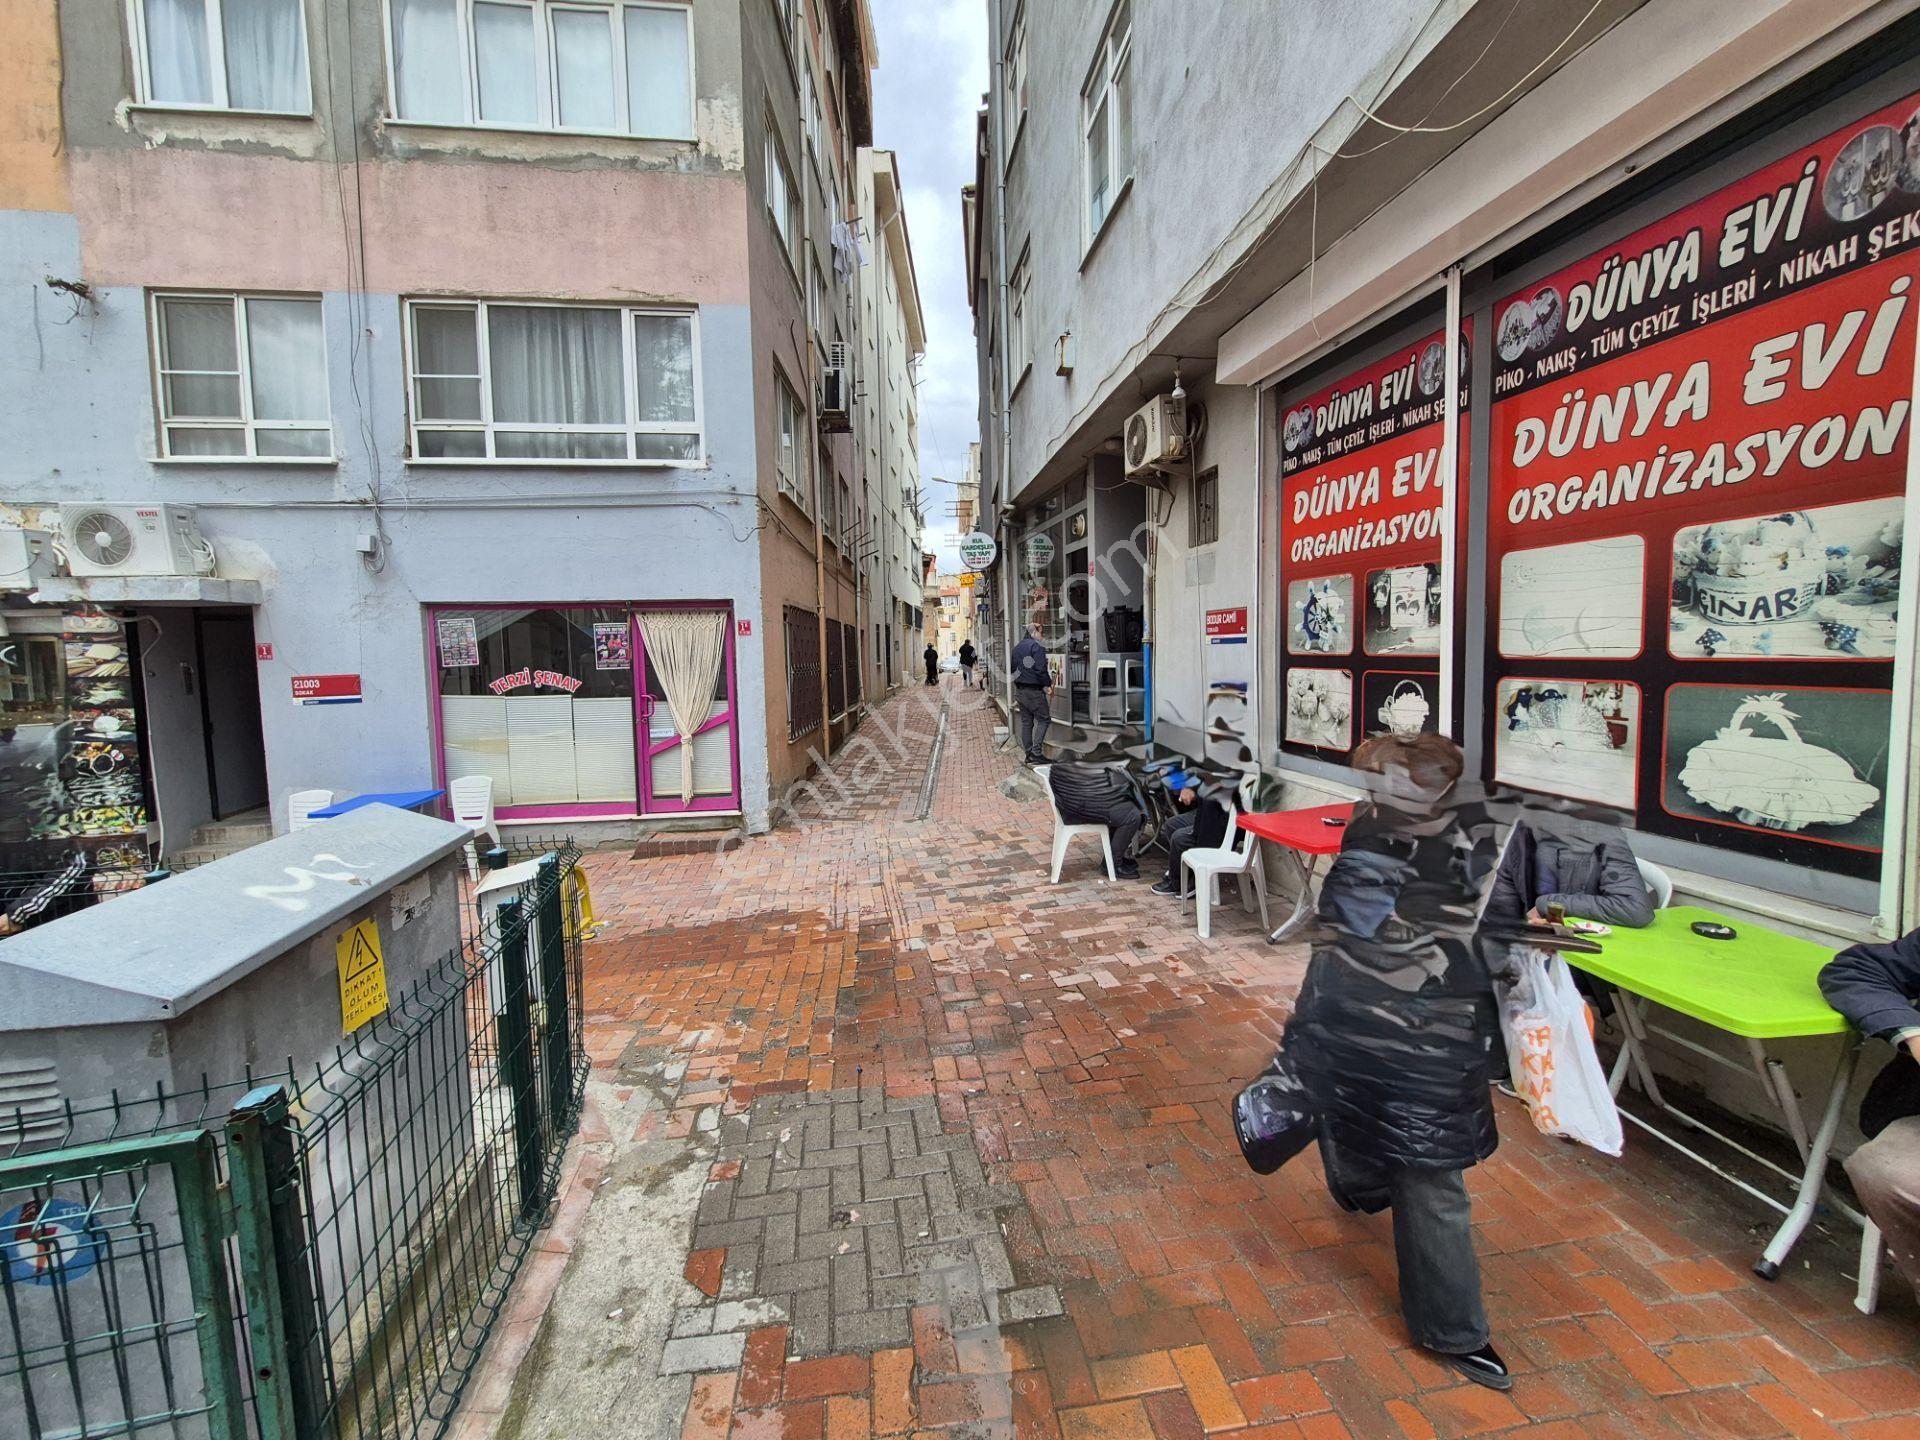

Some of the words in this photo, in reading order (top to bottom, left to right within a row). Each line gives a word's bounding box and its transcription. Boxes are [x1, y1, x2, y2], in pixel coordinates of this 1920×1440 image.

[1565, 229, 1700, 332] DÜNYA
[1719, 159, 1818, 269] EVİ
[1495, 368, 1524, 394] PİKO
[1536, 346, 1577, 379] NAKIŞ
[1591, 327, 1624, 358] TÜM
[1629, 304, 1680, 349] ÇEYİZ
[1691, 268, 1756, 322] İŞLERİ
[1780, 234, 1858, 288] NİKAH
[1315, 383, 1374, 438] DÜNYA
[1379, 354, 1417, 410] EVİ
[1512, 360, 1710, 468] DÜNYA
[1742, 276, 1912, 406] EVİ
[1327, 437, 1342, 456] TÜM
[1343, 427, 1365, 453] ÇEYİZ
[1402, 403, 1432, 428] NİKAH
[1507, 400, 1909, 524] ORGANİZASYON
[1293, 467, 1380, 524] DÜNYA
[293, 679, 320, 689] 21003
[489, 667, 531, 695] TERZİ
[534, 670, 582, 693] ŞENAY
